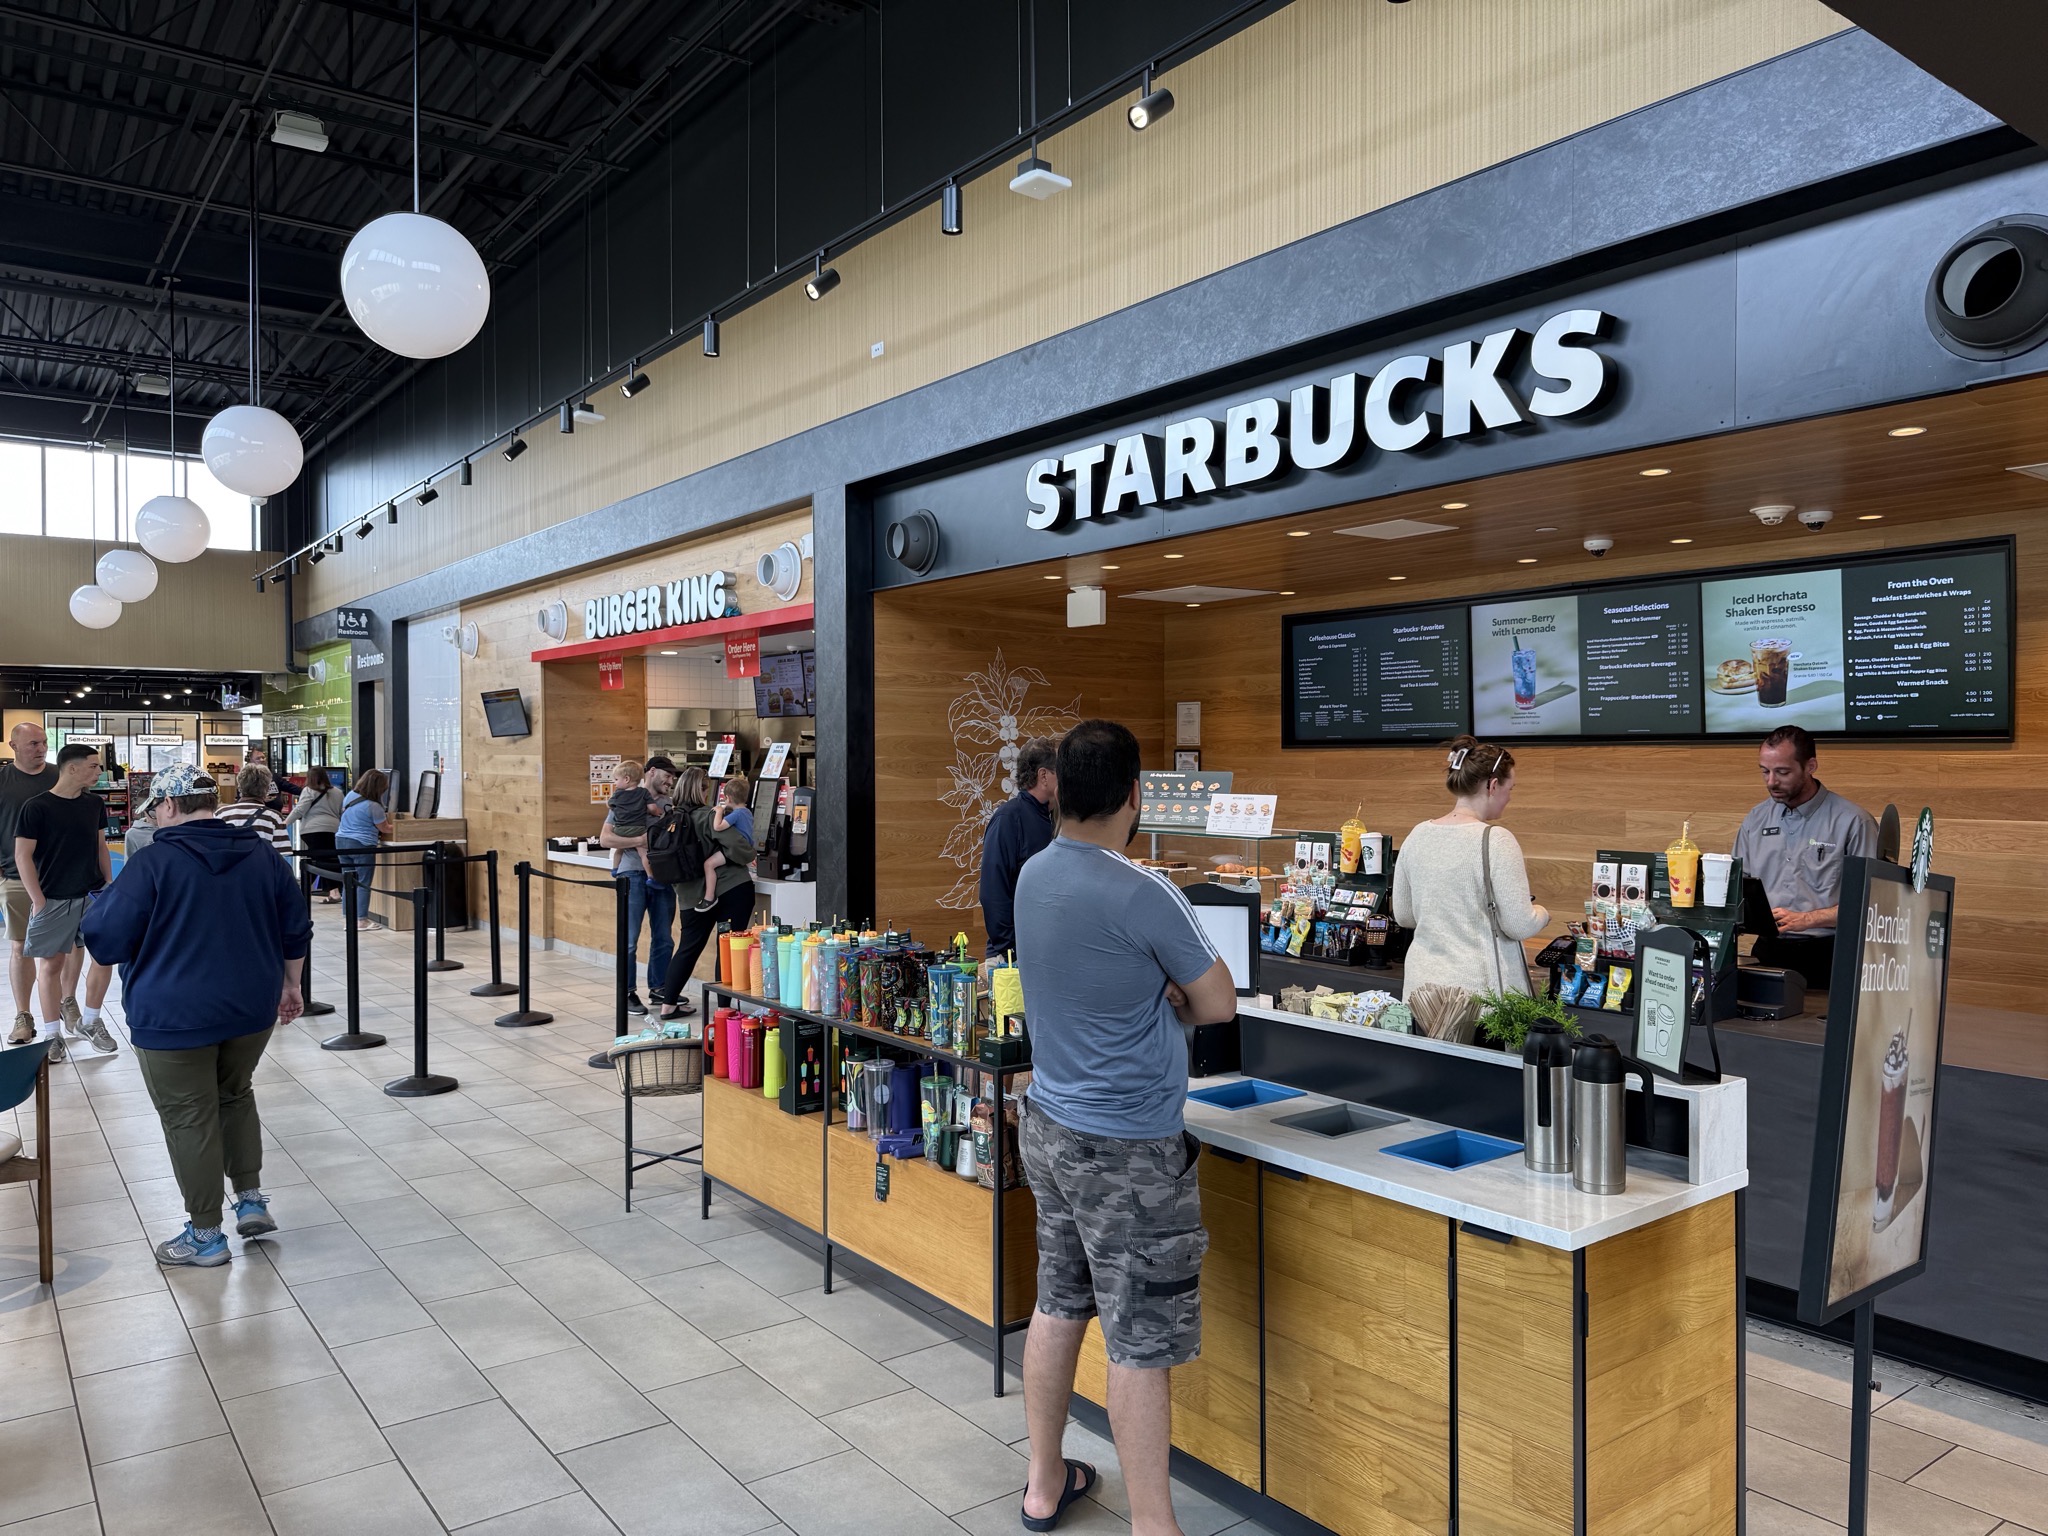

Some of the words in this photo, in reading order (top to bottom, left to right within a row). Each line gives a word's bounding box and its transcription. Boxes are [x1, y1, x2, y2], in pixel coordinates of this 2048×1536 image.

[1025, 309, 1604, 531] STARBUCKS
[1888, 581, 1910, 589] From
[1912, 579, 1927, 587] the
[1929, 577, 1953, 585] Oven
[1733, 595, 1754, 605] Iced
[1757, 591, 1808, 602] Horchata
[1872, 595, 1902, 603] Breakfast
[585, 585, 662, 639] BURGER
[667, 570, 726, 627] KING
[1603, 605, 1633, 614] Seasonal
[1634, 603, 1669, 611] Selections
[1726, 608, 1764, 618] Shaken
[1767, 603, 1816, 615] Espresso
[1492, 615, 1555, 626] Summer-Berry
[1393, 626, 1418, 634] Starbucks
[1421, 624, 1445, 632] Favorites
[1492, 628, 1510, 636] with
[1512, 624, 1556, 635] Lemonade
[1309, 634, 1337, 642] Coffeehouse
[728, 644, 742, 654] Order
[743, 642, 756, 652] Here
[357, 653, 384, 669] Restrooms
[612, 662, 622, 670] Here
[1865, 903, 1911, 944] Blended
[1664, 974, 1675, 982] order
[1861, 953, 1886, 992] and
[1887, 954, 1910, 992] Cool
[1645, 978, 1657, 986] ahead
[1666, 983, 1677, 992] time?
